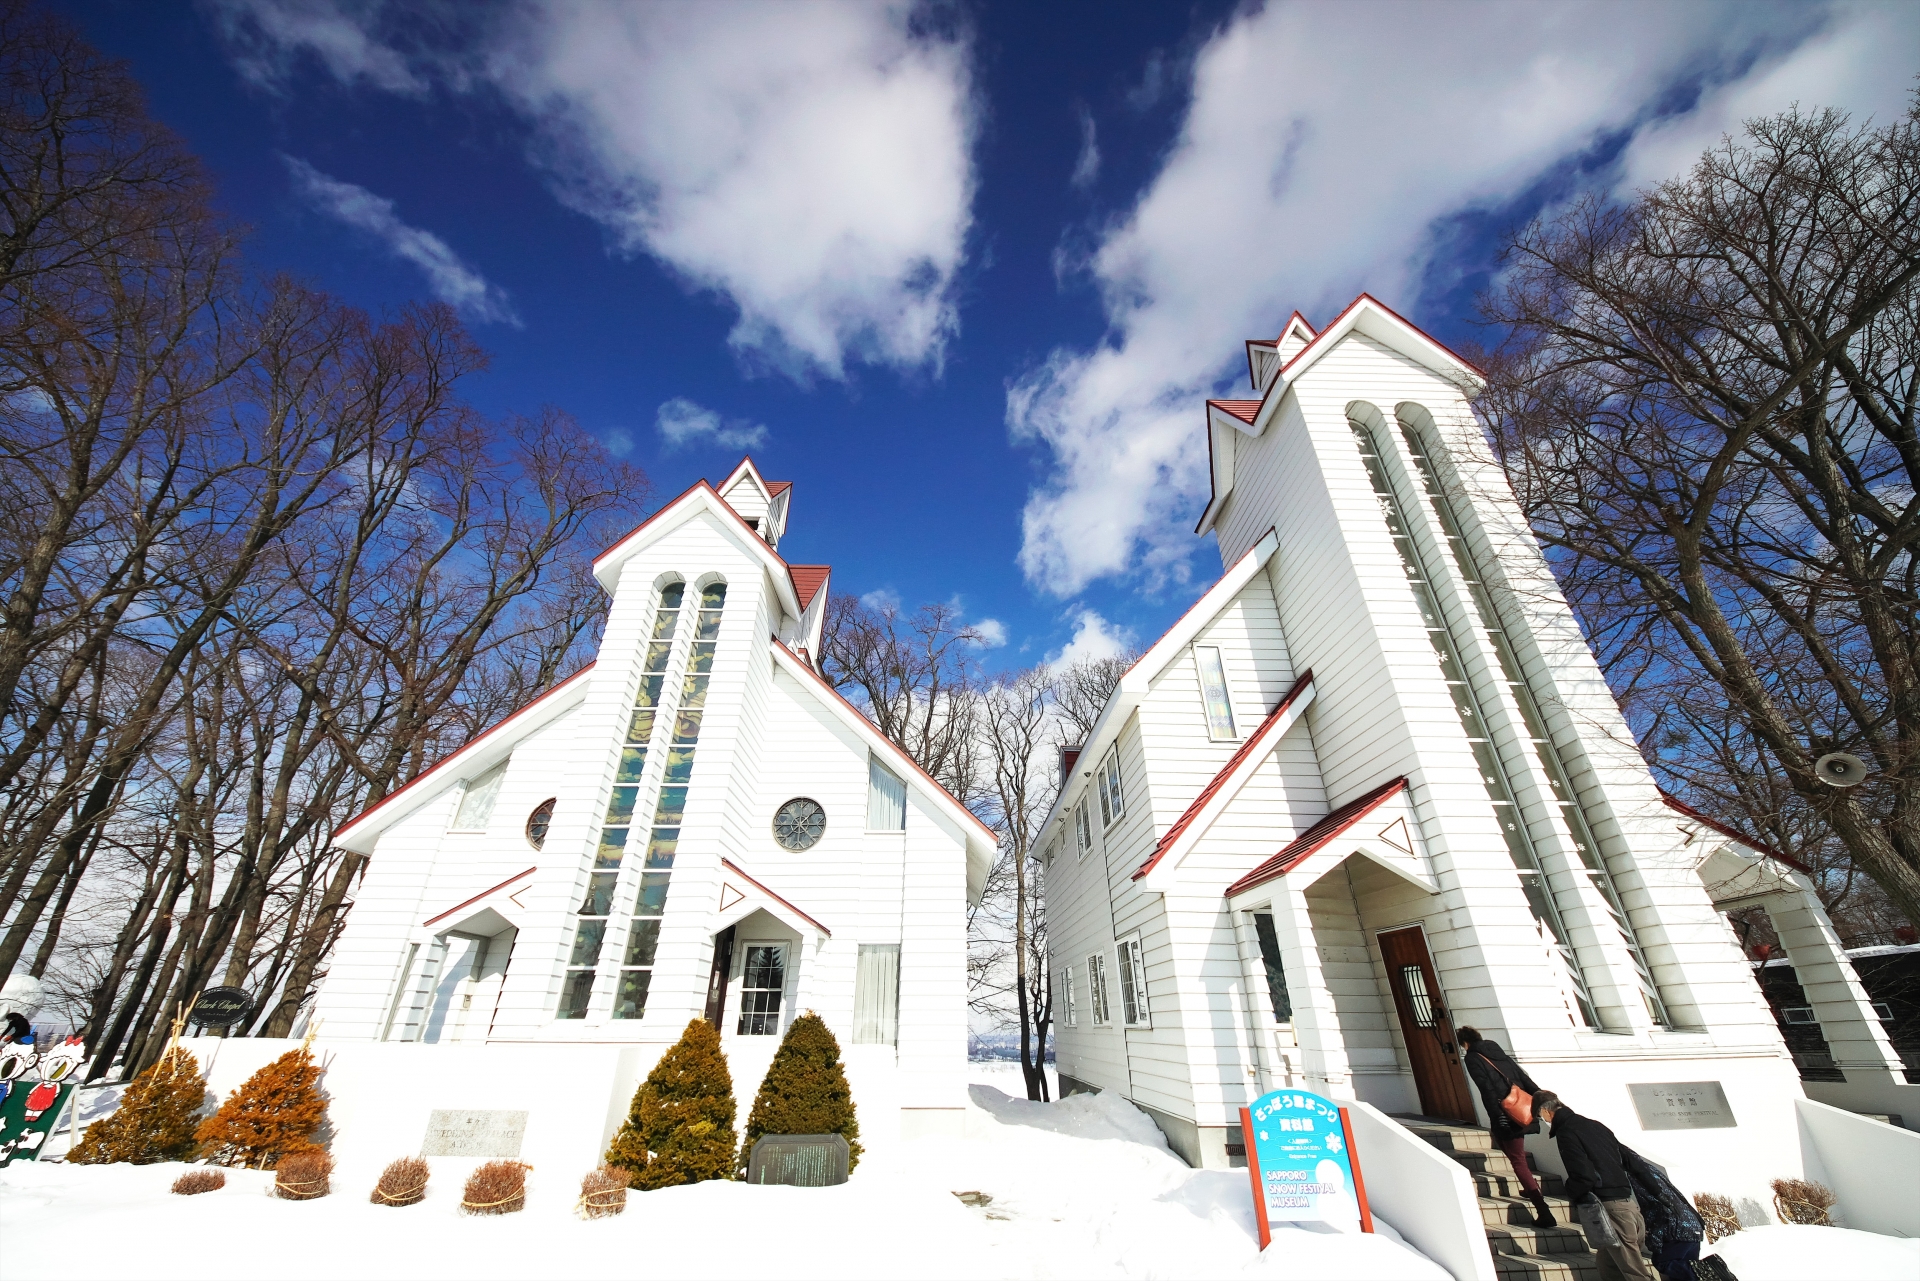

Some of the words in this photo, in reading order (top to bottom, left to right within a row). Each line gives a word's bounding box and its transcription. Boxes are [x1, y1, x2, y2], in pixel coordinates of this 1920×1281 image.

[195, 999, 218, 1009] Clark
[217, 999, 246, 1013] Chapel
[1266, 1170, 1307, 1181] SAPPORO
[1268, 1183, 1297, 1194] SNOW
[1299, 1183, 1336, 1194] FESTIVAL
[1271, 1196, 1310, 1208] MUSEUM
